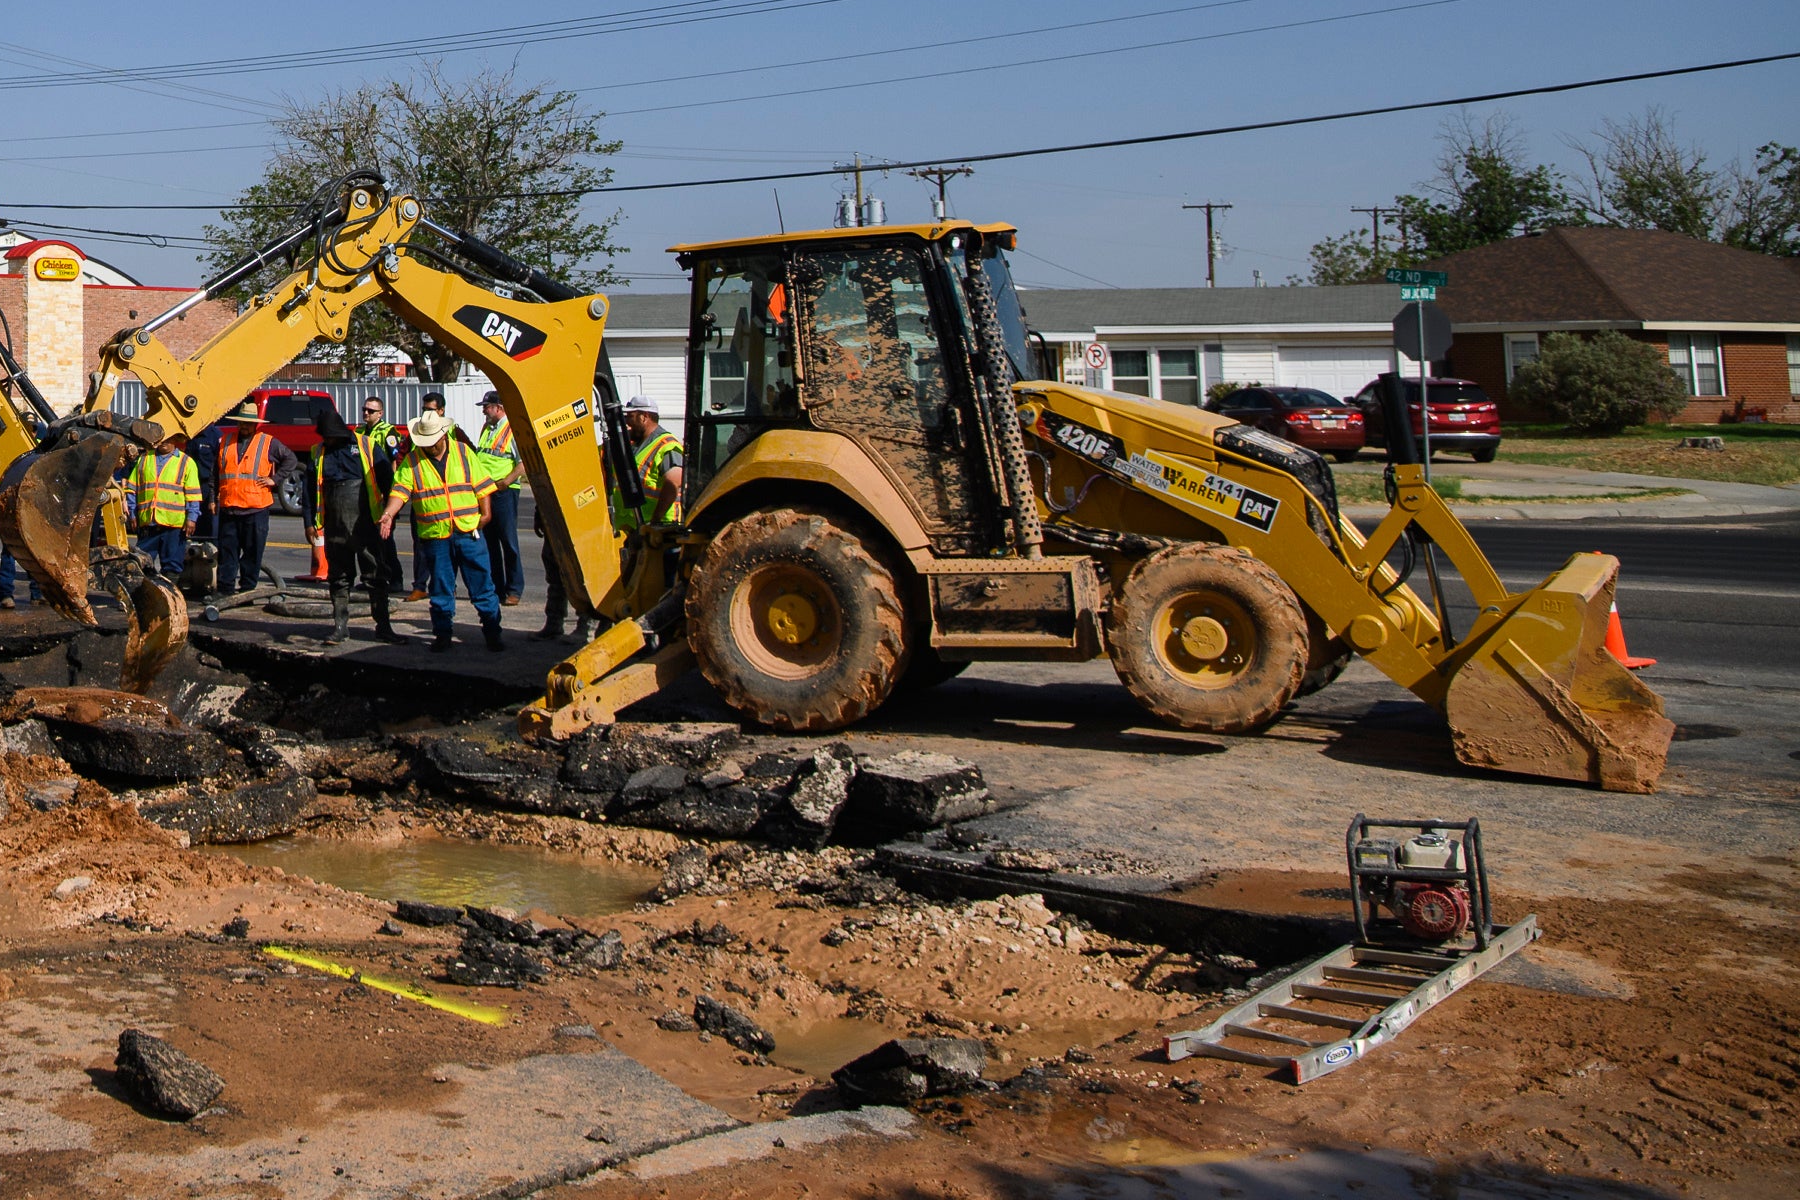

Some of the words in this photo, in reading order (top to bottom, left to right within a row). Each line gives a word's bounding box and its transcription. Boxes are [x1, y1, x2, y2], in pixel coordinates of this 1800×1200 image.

[42, 260, 73, 270] Chicken
[1387, 270, 1402, 282] 42
[1405, 271, 1422, 283] ND
[481, 312, 522, 353] CAT
[543, 412, 571, 429] WARREN
[573, 402, 586, 415] CAT
[1115, 460, 1169, 490] DISTRIBUTION
[1132, 454, 1162, 474] WATER
[1163, 466, 1227, 504] WARREN
[1204, 475, 1243, 498] 4141
[1241, 498, 1274, 522] CAT
